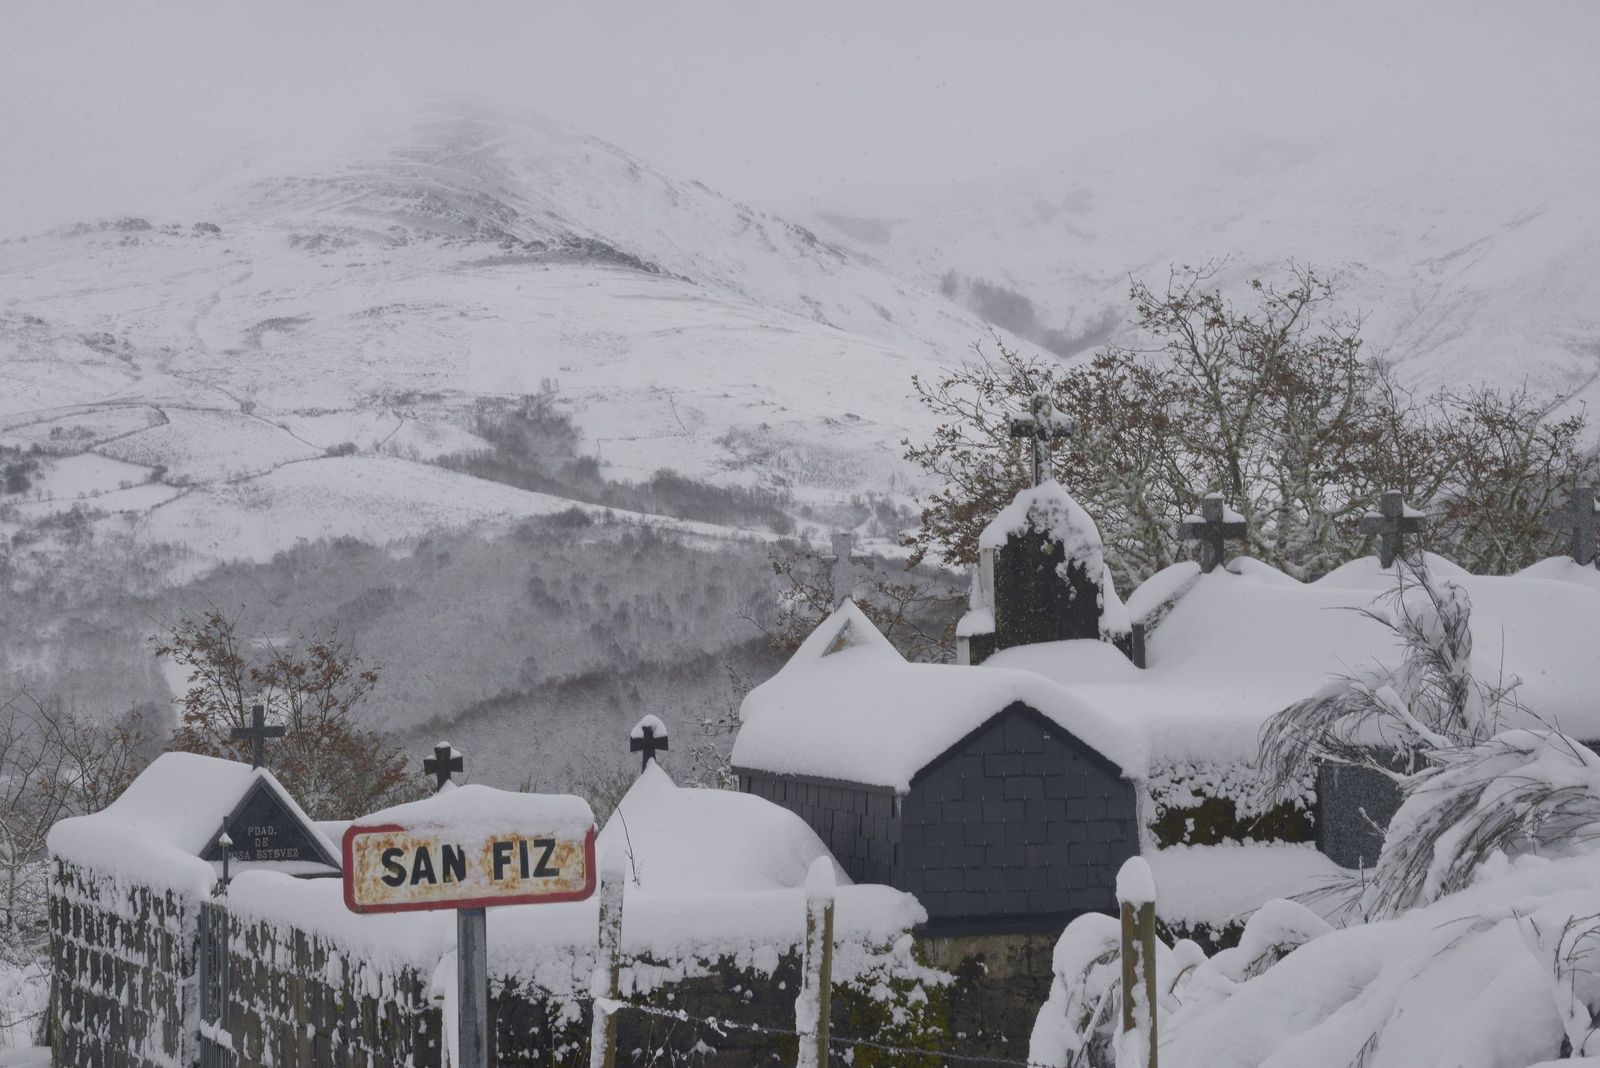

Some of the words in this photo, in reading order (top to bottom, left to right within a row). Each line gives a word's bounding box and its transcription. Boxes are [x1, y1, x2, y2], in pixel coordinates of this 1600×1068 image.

[254, 837, 269, 847] DE
[381, 844, 467, 887] SAN
[493, 839, 560, 880] FIZ
